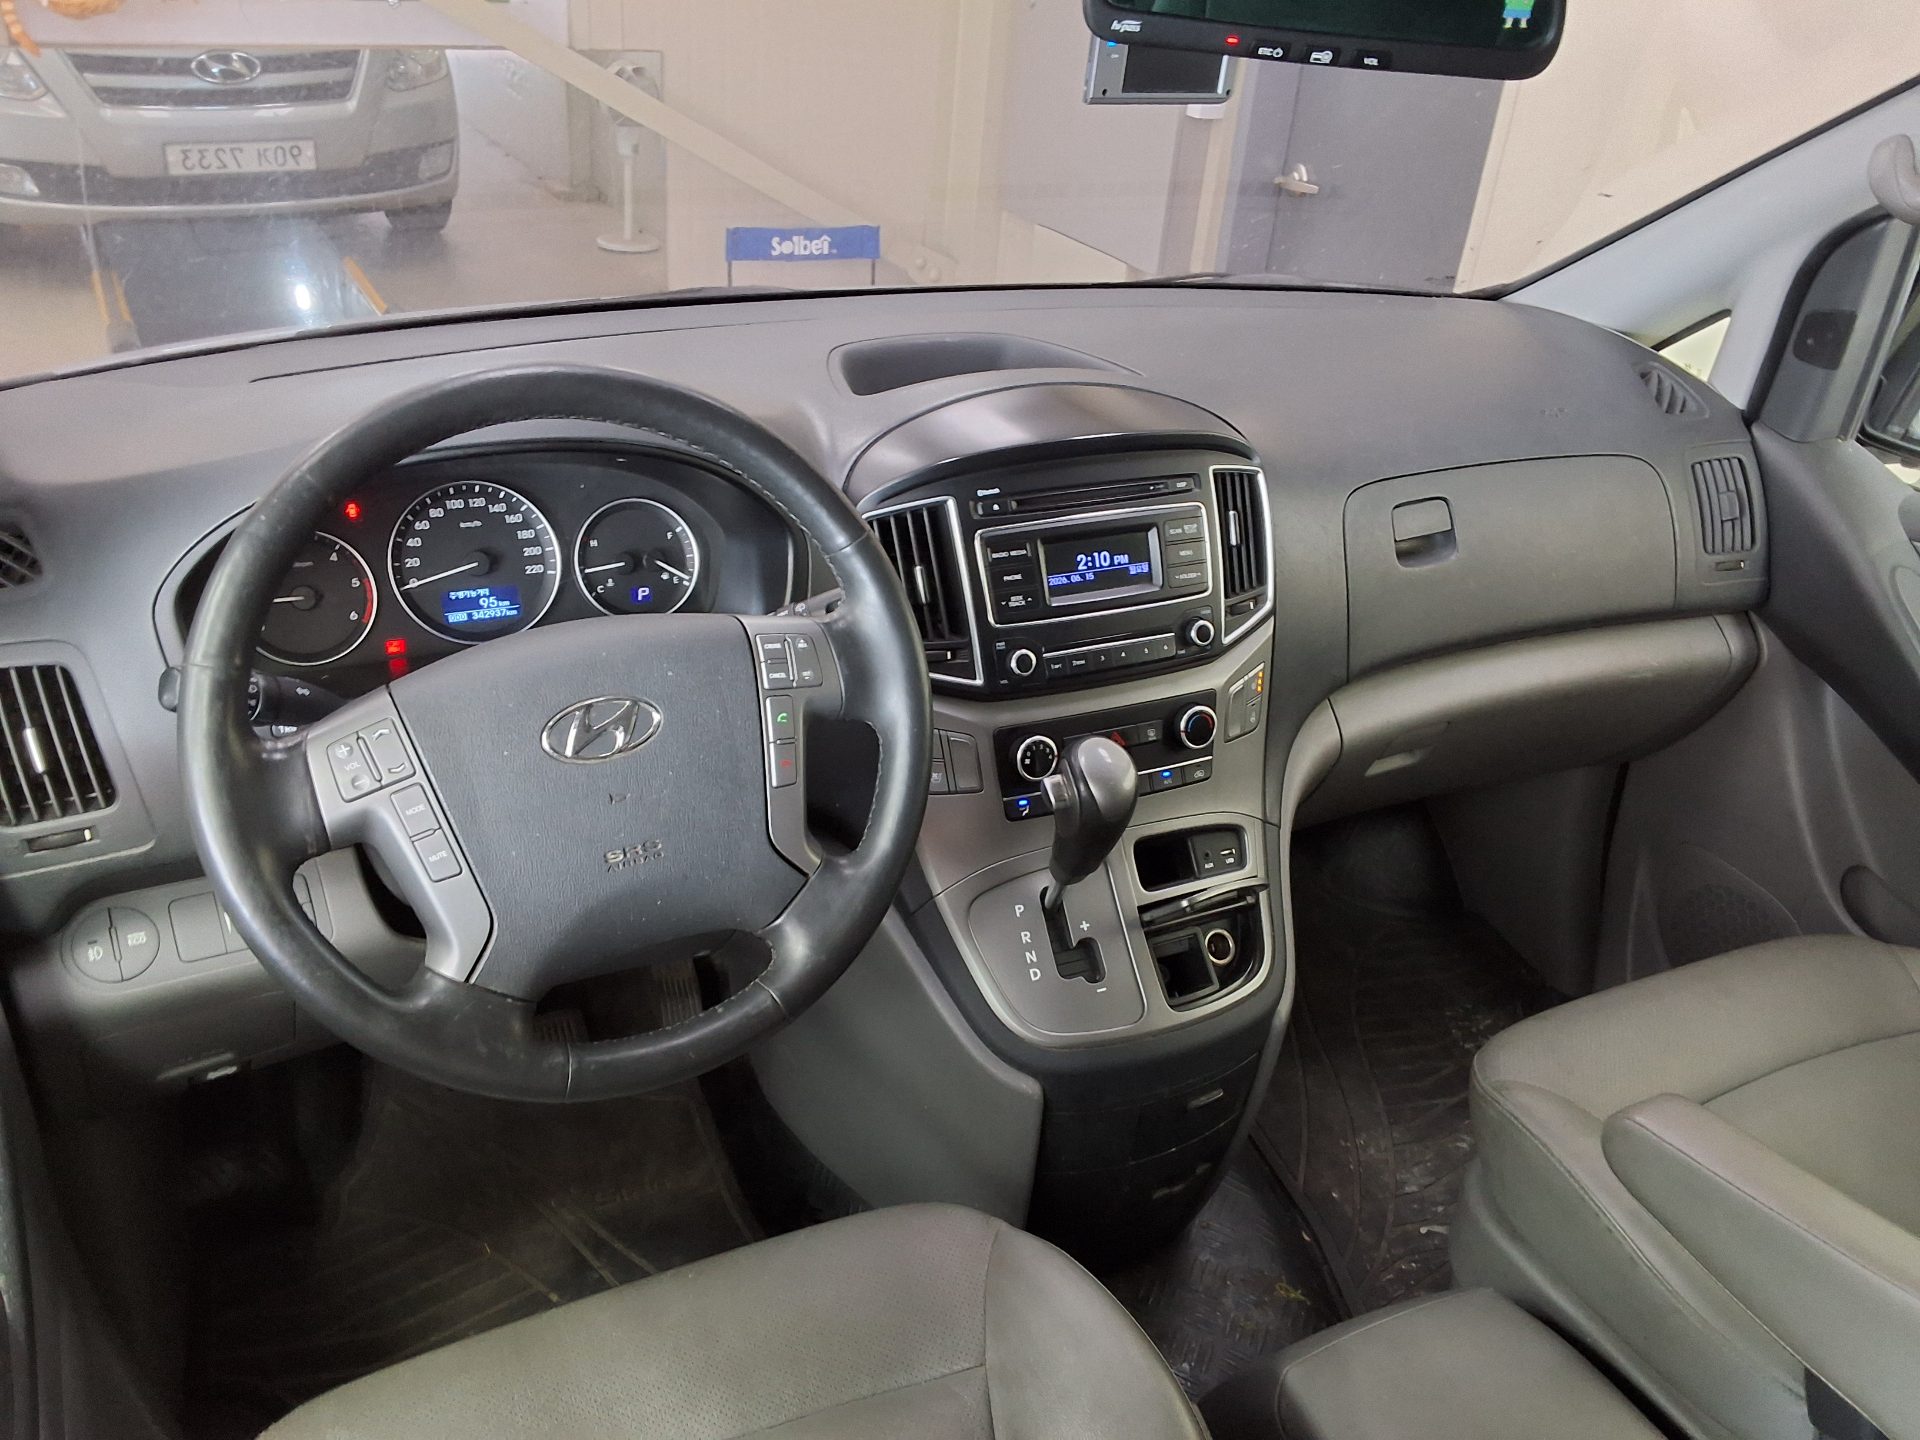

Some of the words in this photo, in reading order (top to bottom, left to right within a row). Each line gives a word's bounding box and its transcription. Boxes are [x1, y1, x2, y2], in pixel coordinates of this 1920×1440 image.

[445, 499, 465, 509] 100
[468, 497, 486, 507] 120
[428, 508, 445, 518] 80
[488, 503, 507, 513] 140
[504, 513, 523, 523] 160
[414, 520, 431, 530] 60
[516, 529, 536, 539] 180
[406, 537, 422, 547] 40
[329, 551, 338, 562] 4
[522, 546, 542, 557] 200
[404, 558, 421, 568] 20
[1076, 550, 1111, 571] 2:10
[1113, 554, 1129, 565] PM
[524, 564, 544, 575] 220
[1085, 571, 1095, 580] 15
[351, 577, 361, 588] 5
[596, 585, 605, 594] C
[637, 587, 650, 601] P
[478, 596, 498, 609] 95
[349, 610, 359, 621] 6
[344, 761, 361, 772] VOL
[405, 802, 427, 816] MODE
[428, 849, 448, 863] MUTE
[1014, 904, 1025, 918] P
[1020, 931, 1032, 945] R
[1025, 950, 1038, 965] N
[1029, 968, 1042, 982] D
